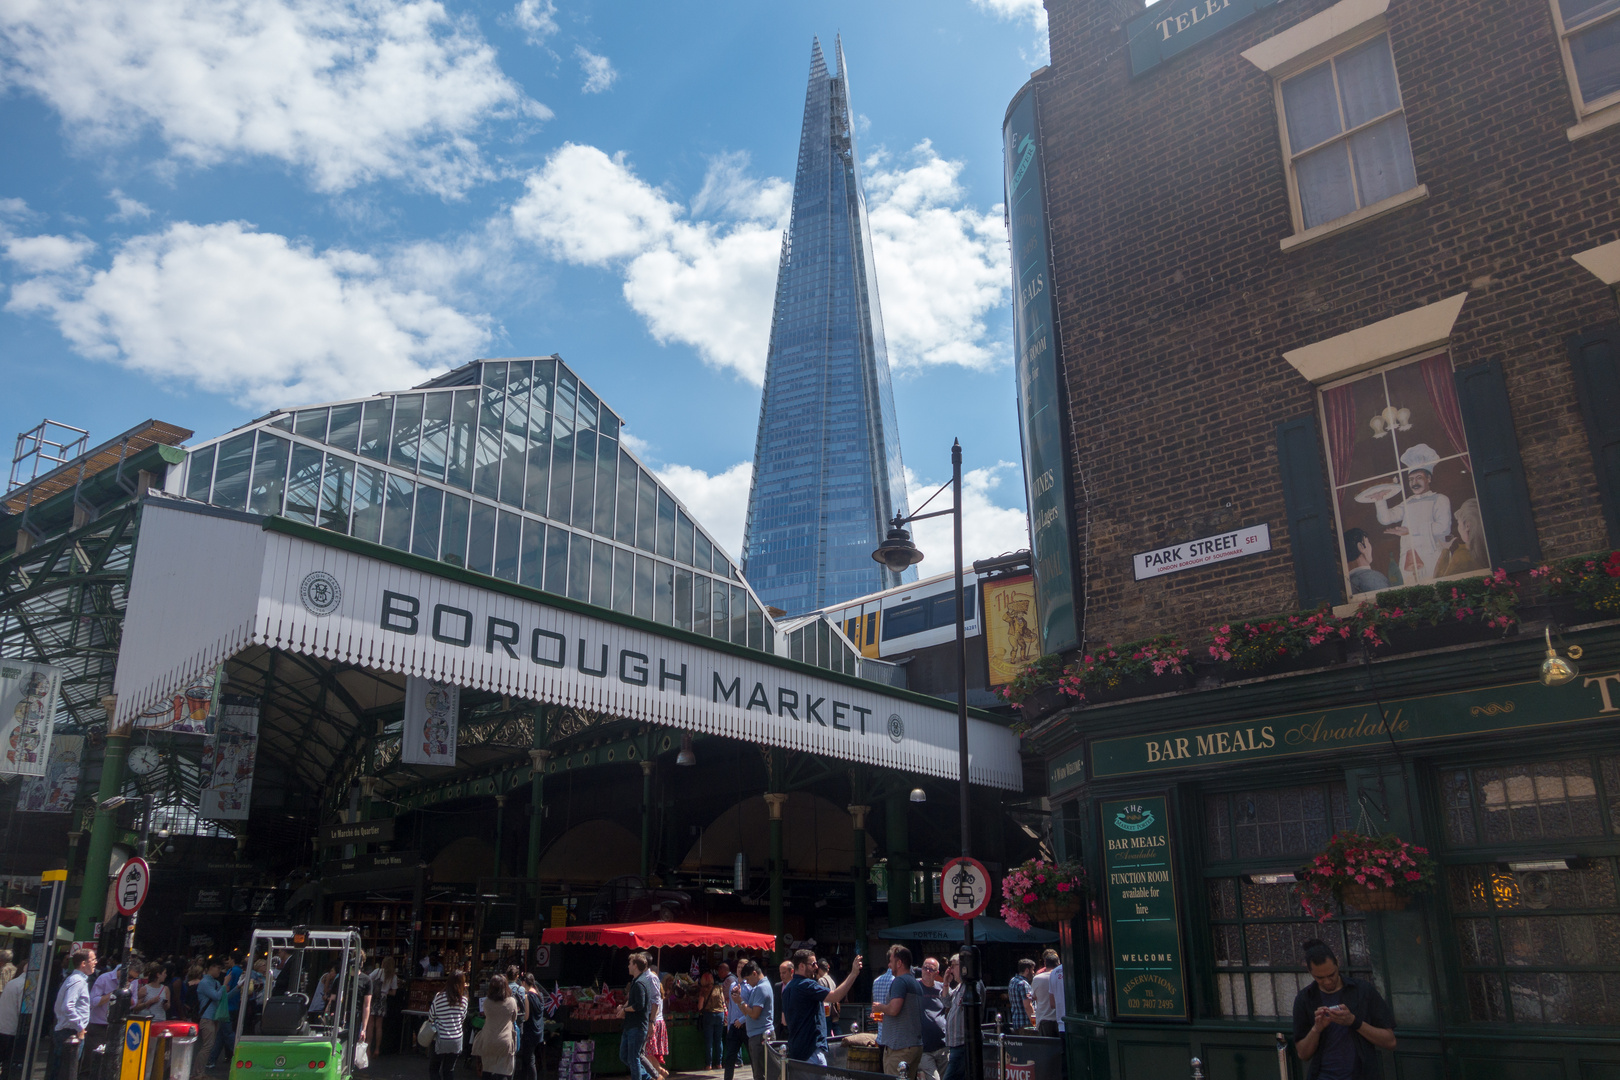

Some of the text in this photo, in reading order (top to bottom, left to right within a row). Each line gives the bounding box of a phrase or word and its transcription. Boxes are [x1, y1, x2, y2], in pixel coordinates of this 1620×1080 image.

[1156, 0, 1231, 42] TELE
[1145, 534, 1258, 568] PARK STREET SE1
[1158, 564, 1178, 572] LONDON
[1179, 559, 1203, 568] BOROUGH
[1213, 549, 1243, 559] SOUTHWARK
[303, 574, 325, 596] BOROUGH
[995, 590, 1017, 611] The
[380, 590, 872, 736] BOROUGH MARKET
[1146, 708, 1410, 762] BAR MEALS Available
[1123, 804, 1143, 814] THE
[1116, 818, 1153, 830] MARKET PORTER
[361, 826, 380, 837] Quartier
[1108, 835, 1166, 850] BAR MEALS
[1115, 849, 1157, 860] Available
[1111, 871, 1169, 885] FUNCTION ROOM
[1122, 886, 1159, 899] available for
[1135, 903, 1149, 914] hire
[913, 930, 949, 938] PORTEÑA
[540, 952, 544, 960] 5
[1122, 954, 1172, 962] WELCOME
[1123, 974, 1177, 995] RESERVATIONS
[1128, 999, 1174, 1008] 020 7407 2495
